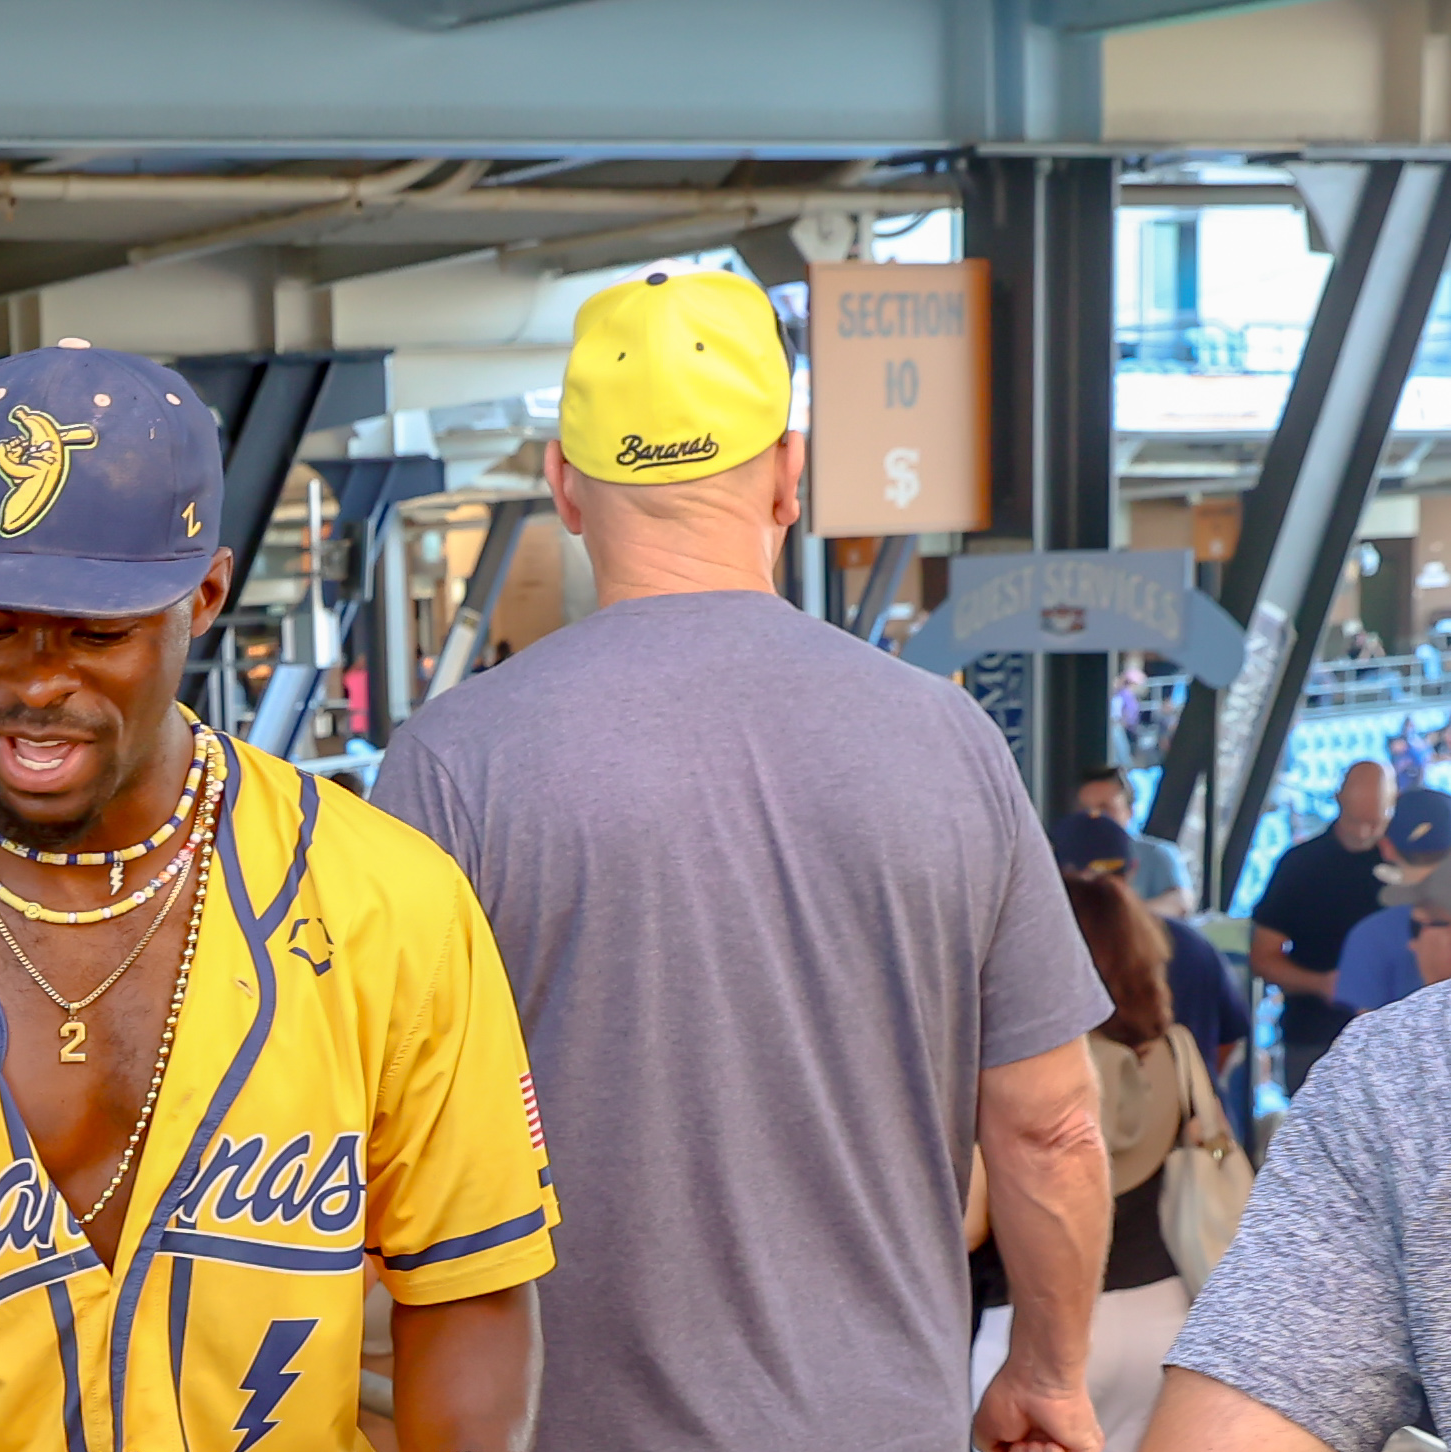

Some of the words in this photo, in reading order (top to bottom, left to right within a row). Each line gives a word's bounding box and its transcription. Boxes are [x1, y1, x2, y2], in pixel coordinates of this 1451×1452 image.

[838, 291, 965, 339] SECTION
[885, 359, 919, 408] 10
[616, 432, 720, 467] Bananas
[181, 502, 202, 538] Z
[954, 565, 1036, 640] GUEST
[1042, 561, 1180, 640] SERVICES
[59, 1022, 86, 1062] 2
